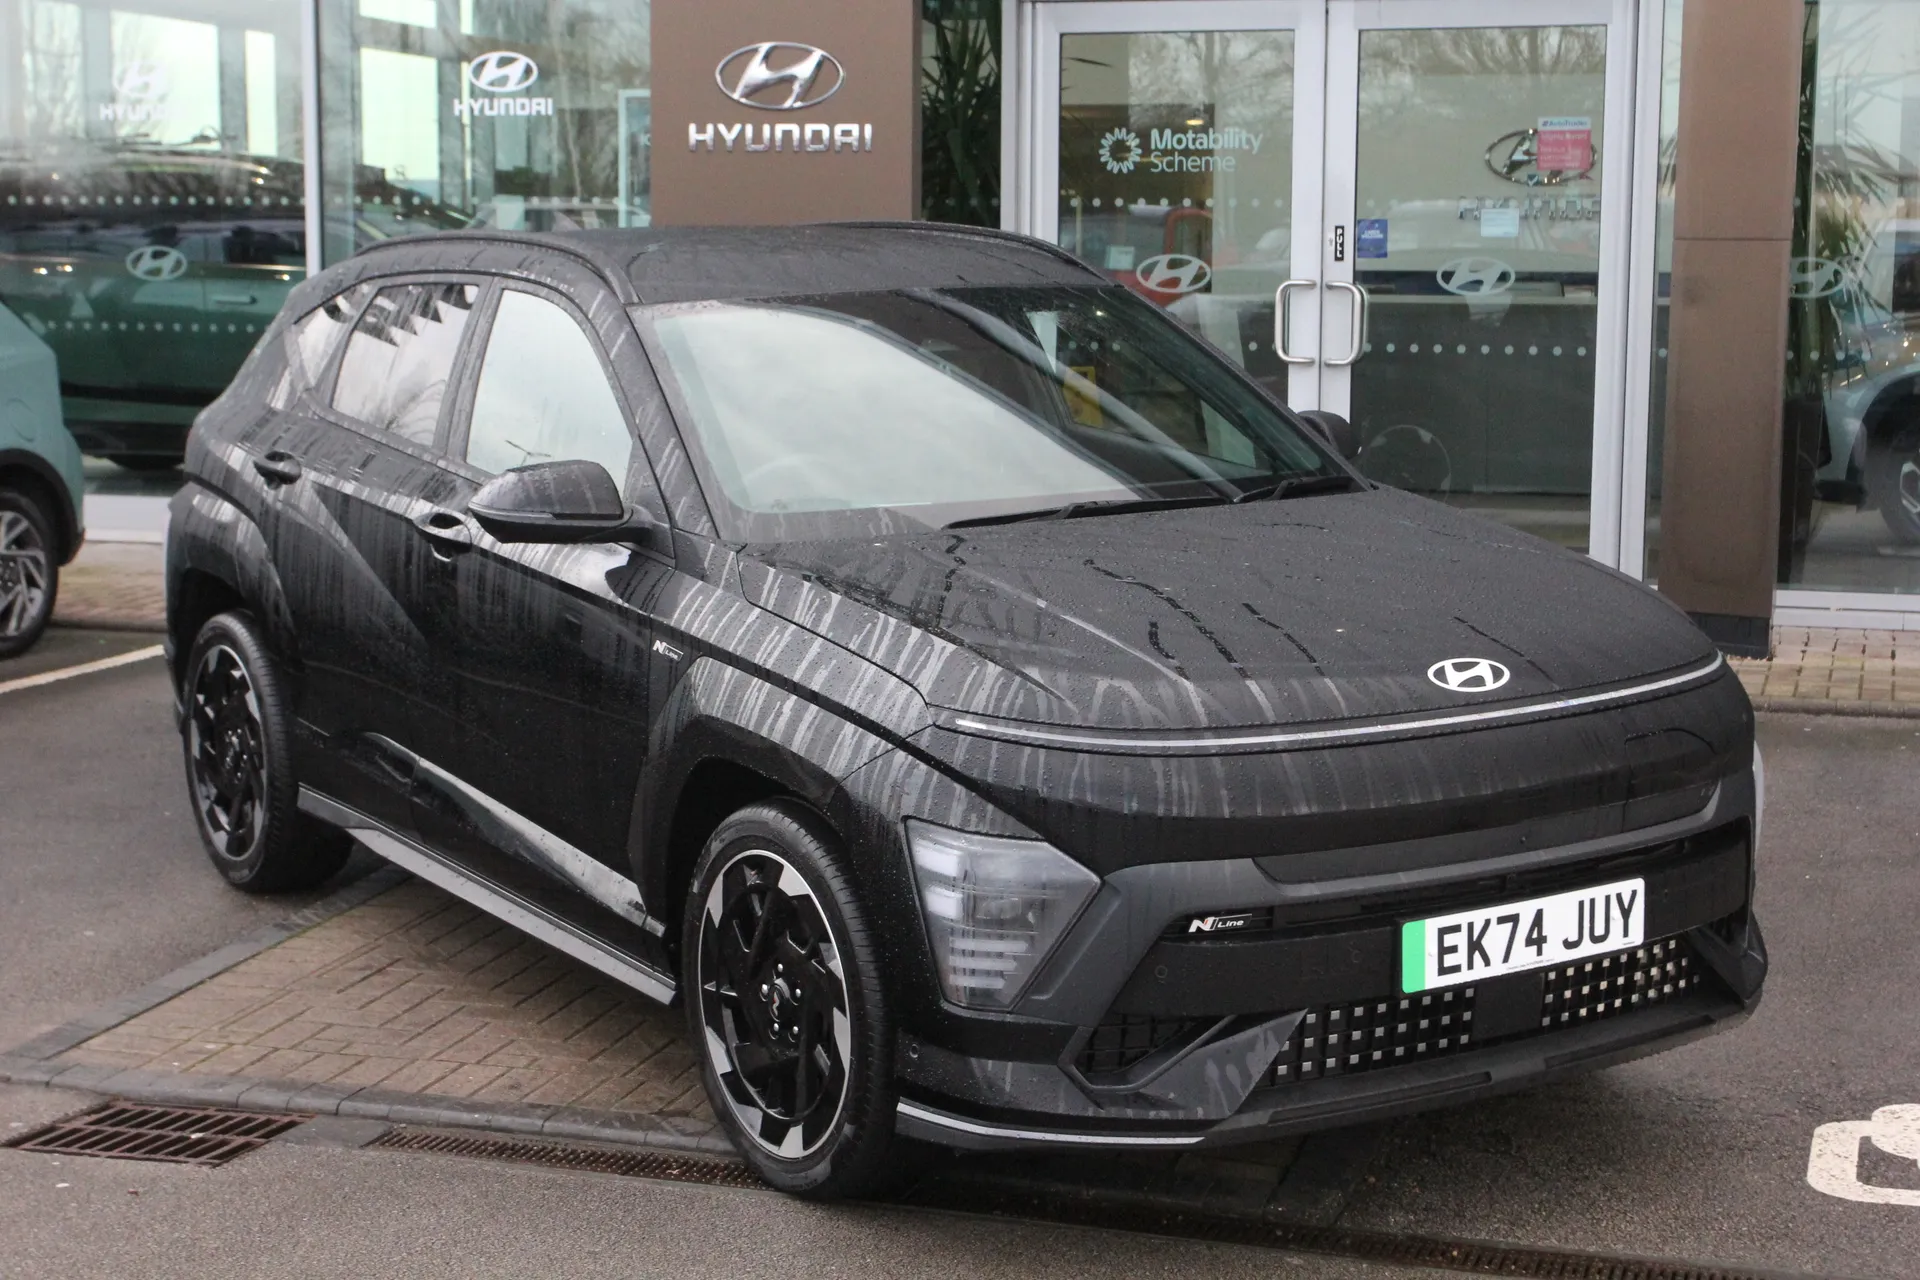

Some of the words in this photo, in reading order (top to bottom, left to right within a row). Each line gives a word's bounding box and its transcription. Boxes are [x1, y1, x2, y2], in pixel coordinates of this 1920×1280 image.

[453, 97, 553, 117] HYUNDAI
[688, 122, 873, 152] HYUNDAI
[1150, 127, 1263, 155] Motability
[1150, 151, 1236, 173] Scheme
[652, 640, 667, 655] N
[1188, 916, 1216, 933] N
[1217, 919, 1245, 929] Line
[1437, 908, 1547, 977] EK74
[1562, 889, 1638, 950] JUY
